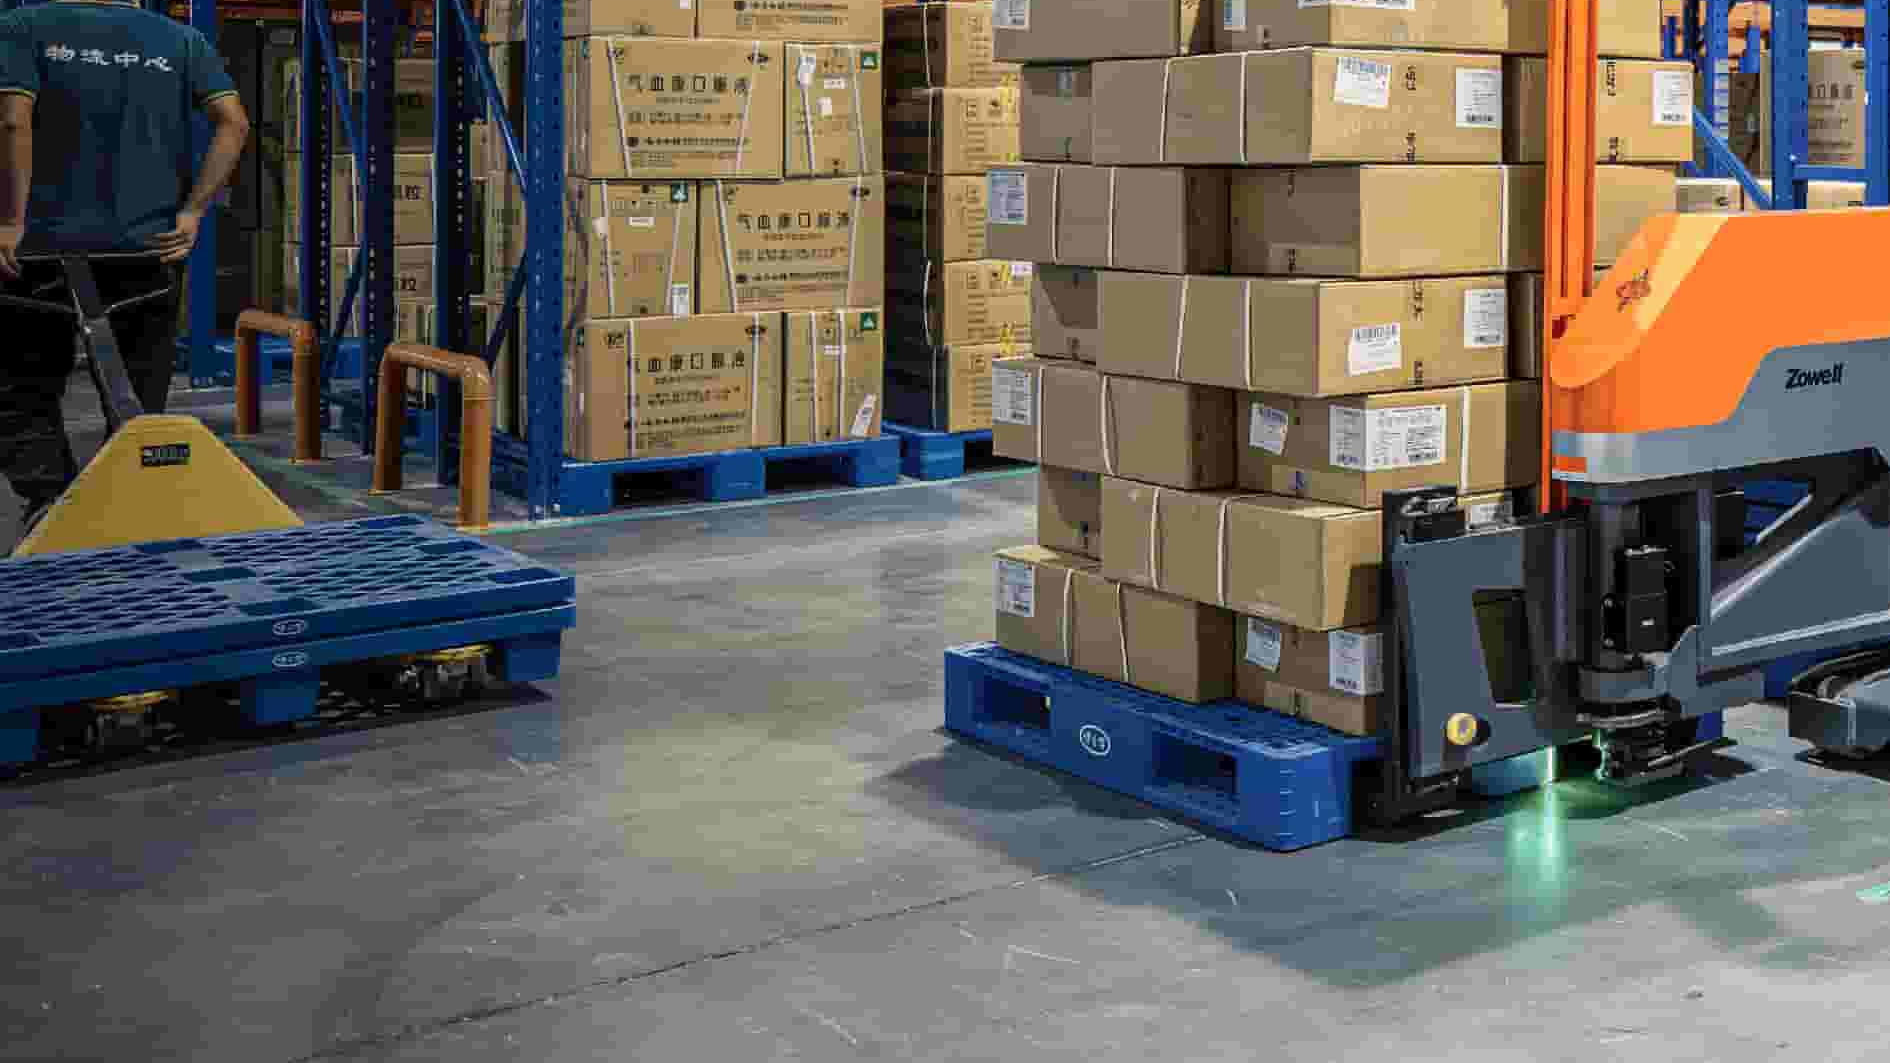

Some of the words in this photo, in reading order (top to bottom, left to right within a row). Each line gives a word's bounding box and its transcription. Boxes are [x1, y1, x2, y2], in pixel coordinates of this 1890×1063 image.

[45, 41, 176, 73] 物流中心
[1784, 362, 1844, 389] Zowell
